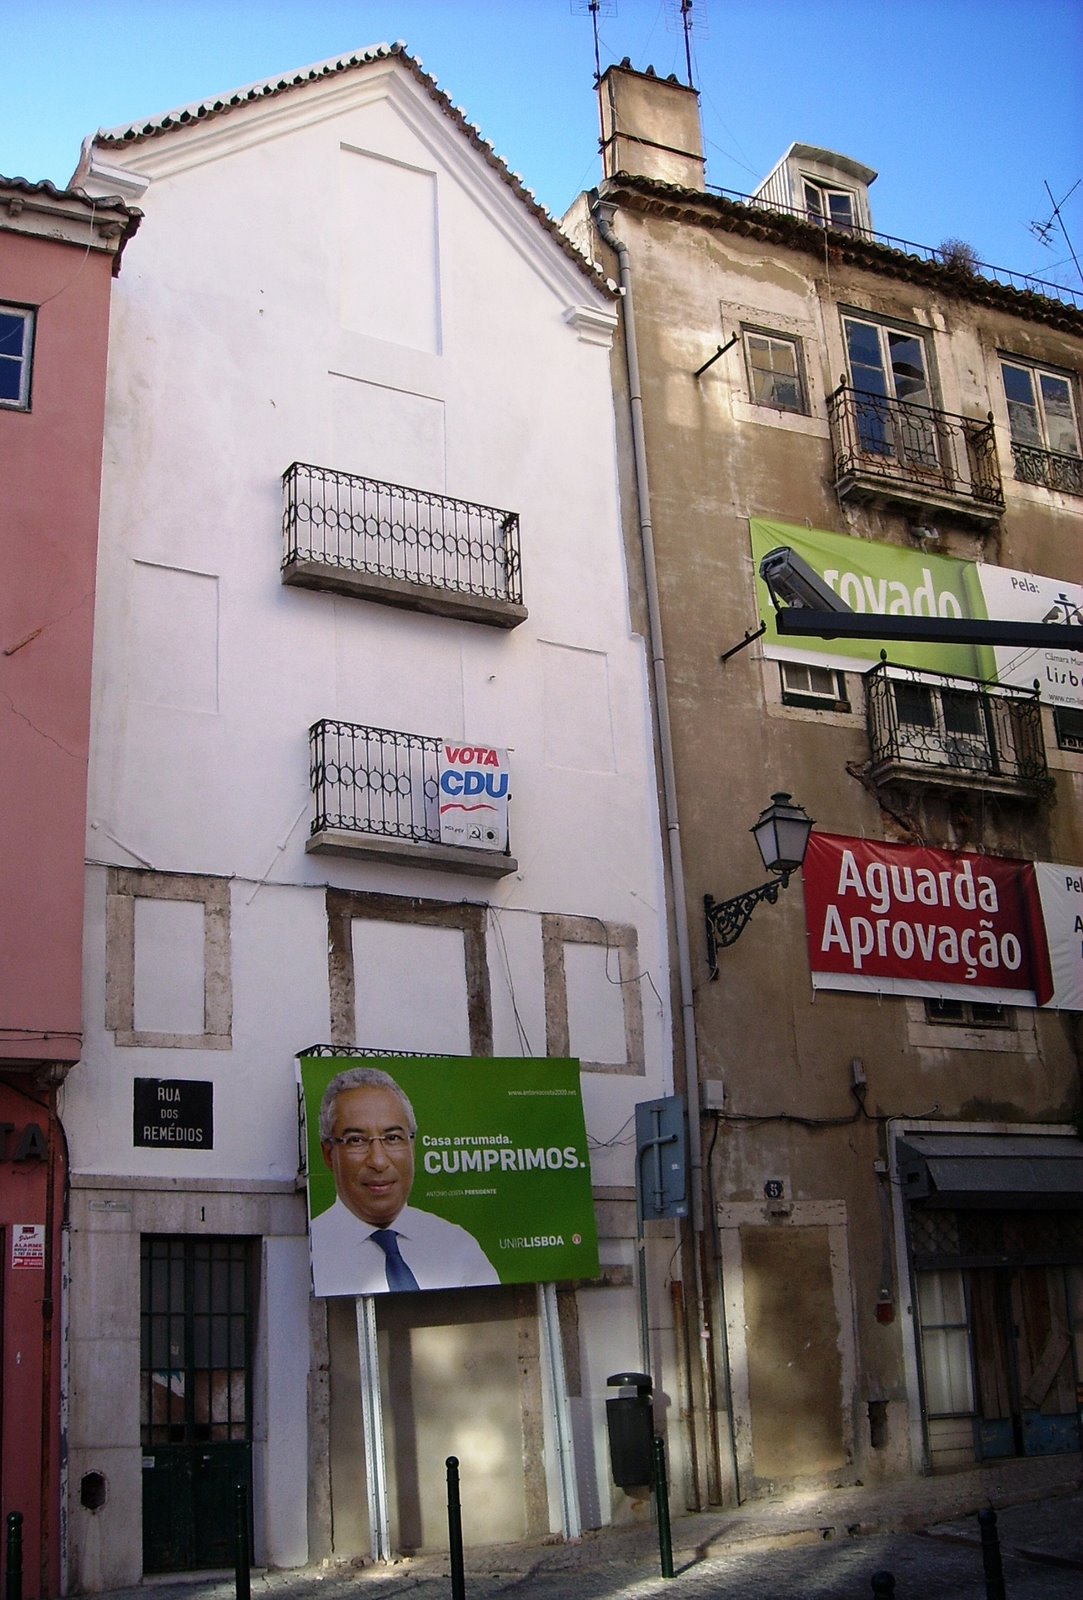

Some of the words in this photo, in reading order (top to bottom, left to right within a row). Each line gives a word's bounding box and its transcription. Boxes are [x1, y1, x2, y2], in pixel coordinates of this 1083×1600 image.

[1011, 576, 1040, 593] Pela:
[445, 746, 499, 767] VOTA
[440, 769, 509, 798] CDU
[838, 850, 999, 914] Aguarda
[821, 904, 1022, 979] Aprovação
[157, 1087, 181, 1102] RUA
[160, 1109, 179, 1119] DOS
[143, 1123, 203, 1143] REMÉDIOS
[422, 1135, 451, 1147] Casa
[453, 1134, 513, 1146] arrumada.
[423, 1147, 586, 1174] CUMPRIMOS.
[499, 1235, 564, 1249] UNIRLISBOA
